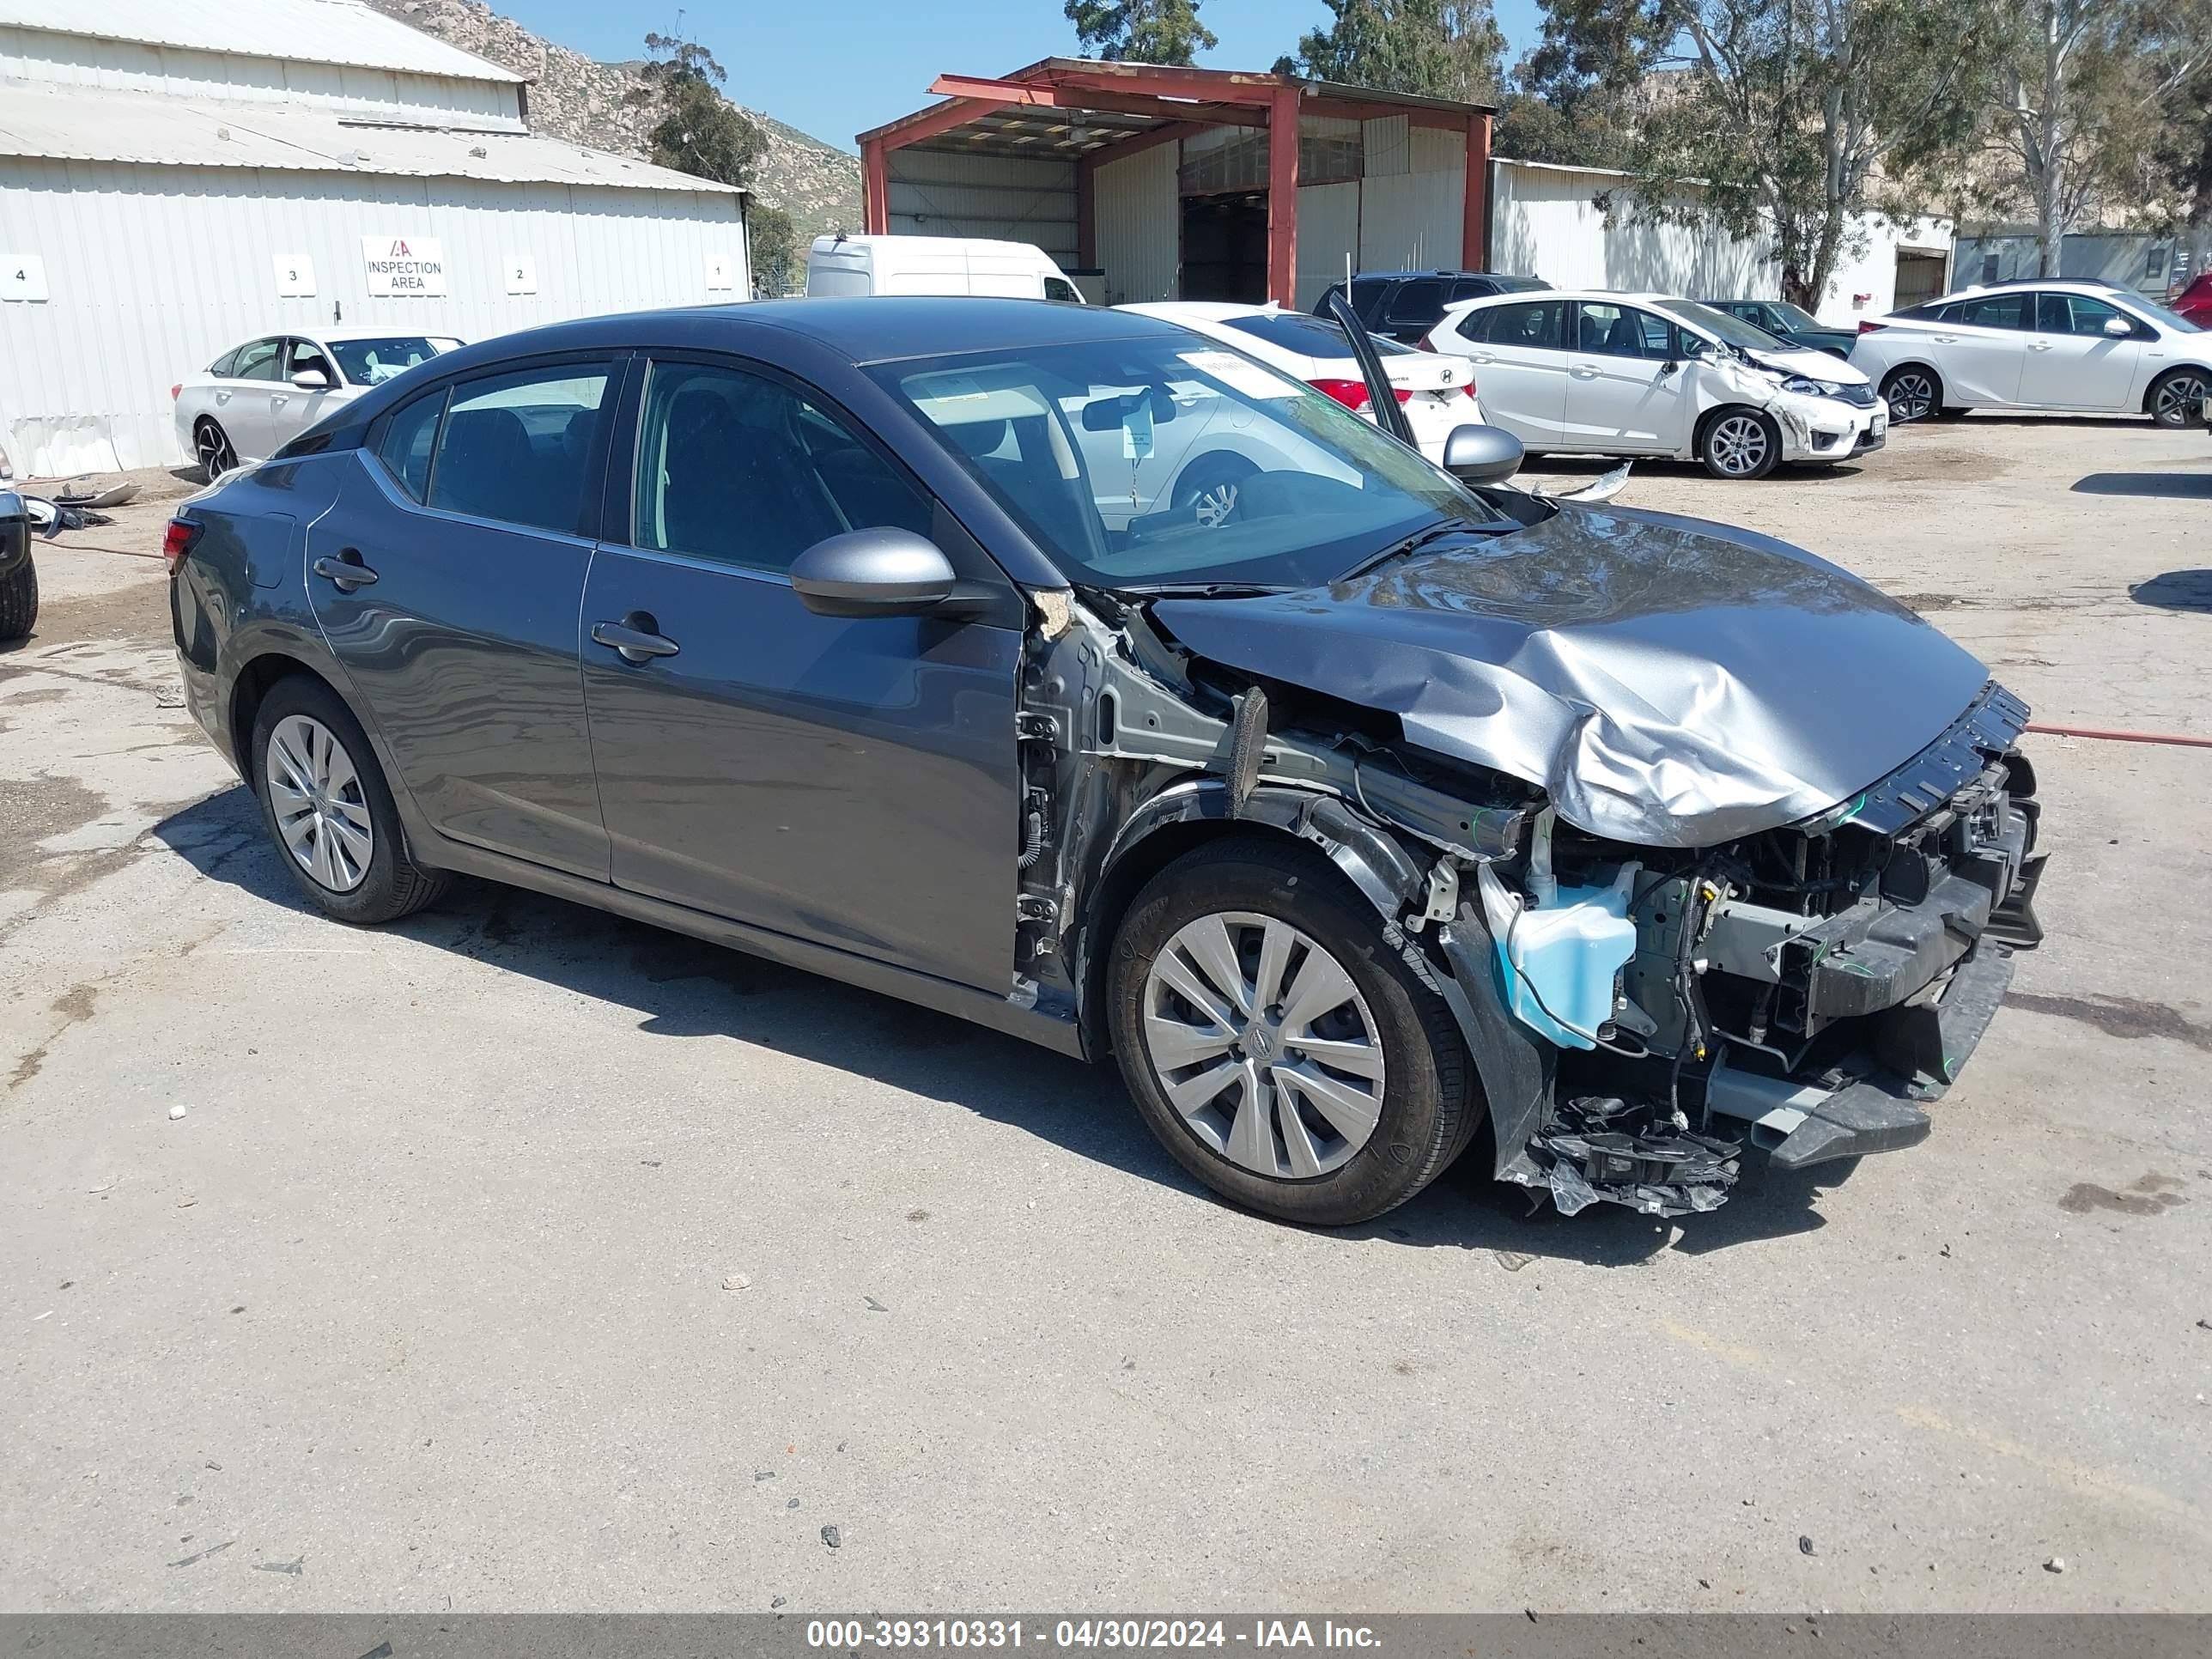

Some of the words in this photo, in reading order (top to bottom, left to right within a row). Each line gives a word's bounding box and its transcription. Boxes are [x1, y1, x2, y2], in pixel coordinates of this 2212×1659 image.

[368, 261, 441, 274] INSPECTION
[715, 266, 720, 276] 1
[15, 269, 26, 282] 4
[289, 270, 297, 282] 3
[516, 269, 524, 279] 2
[392, 276, 425, 289] AREA
